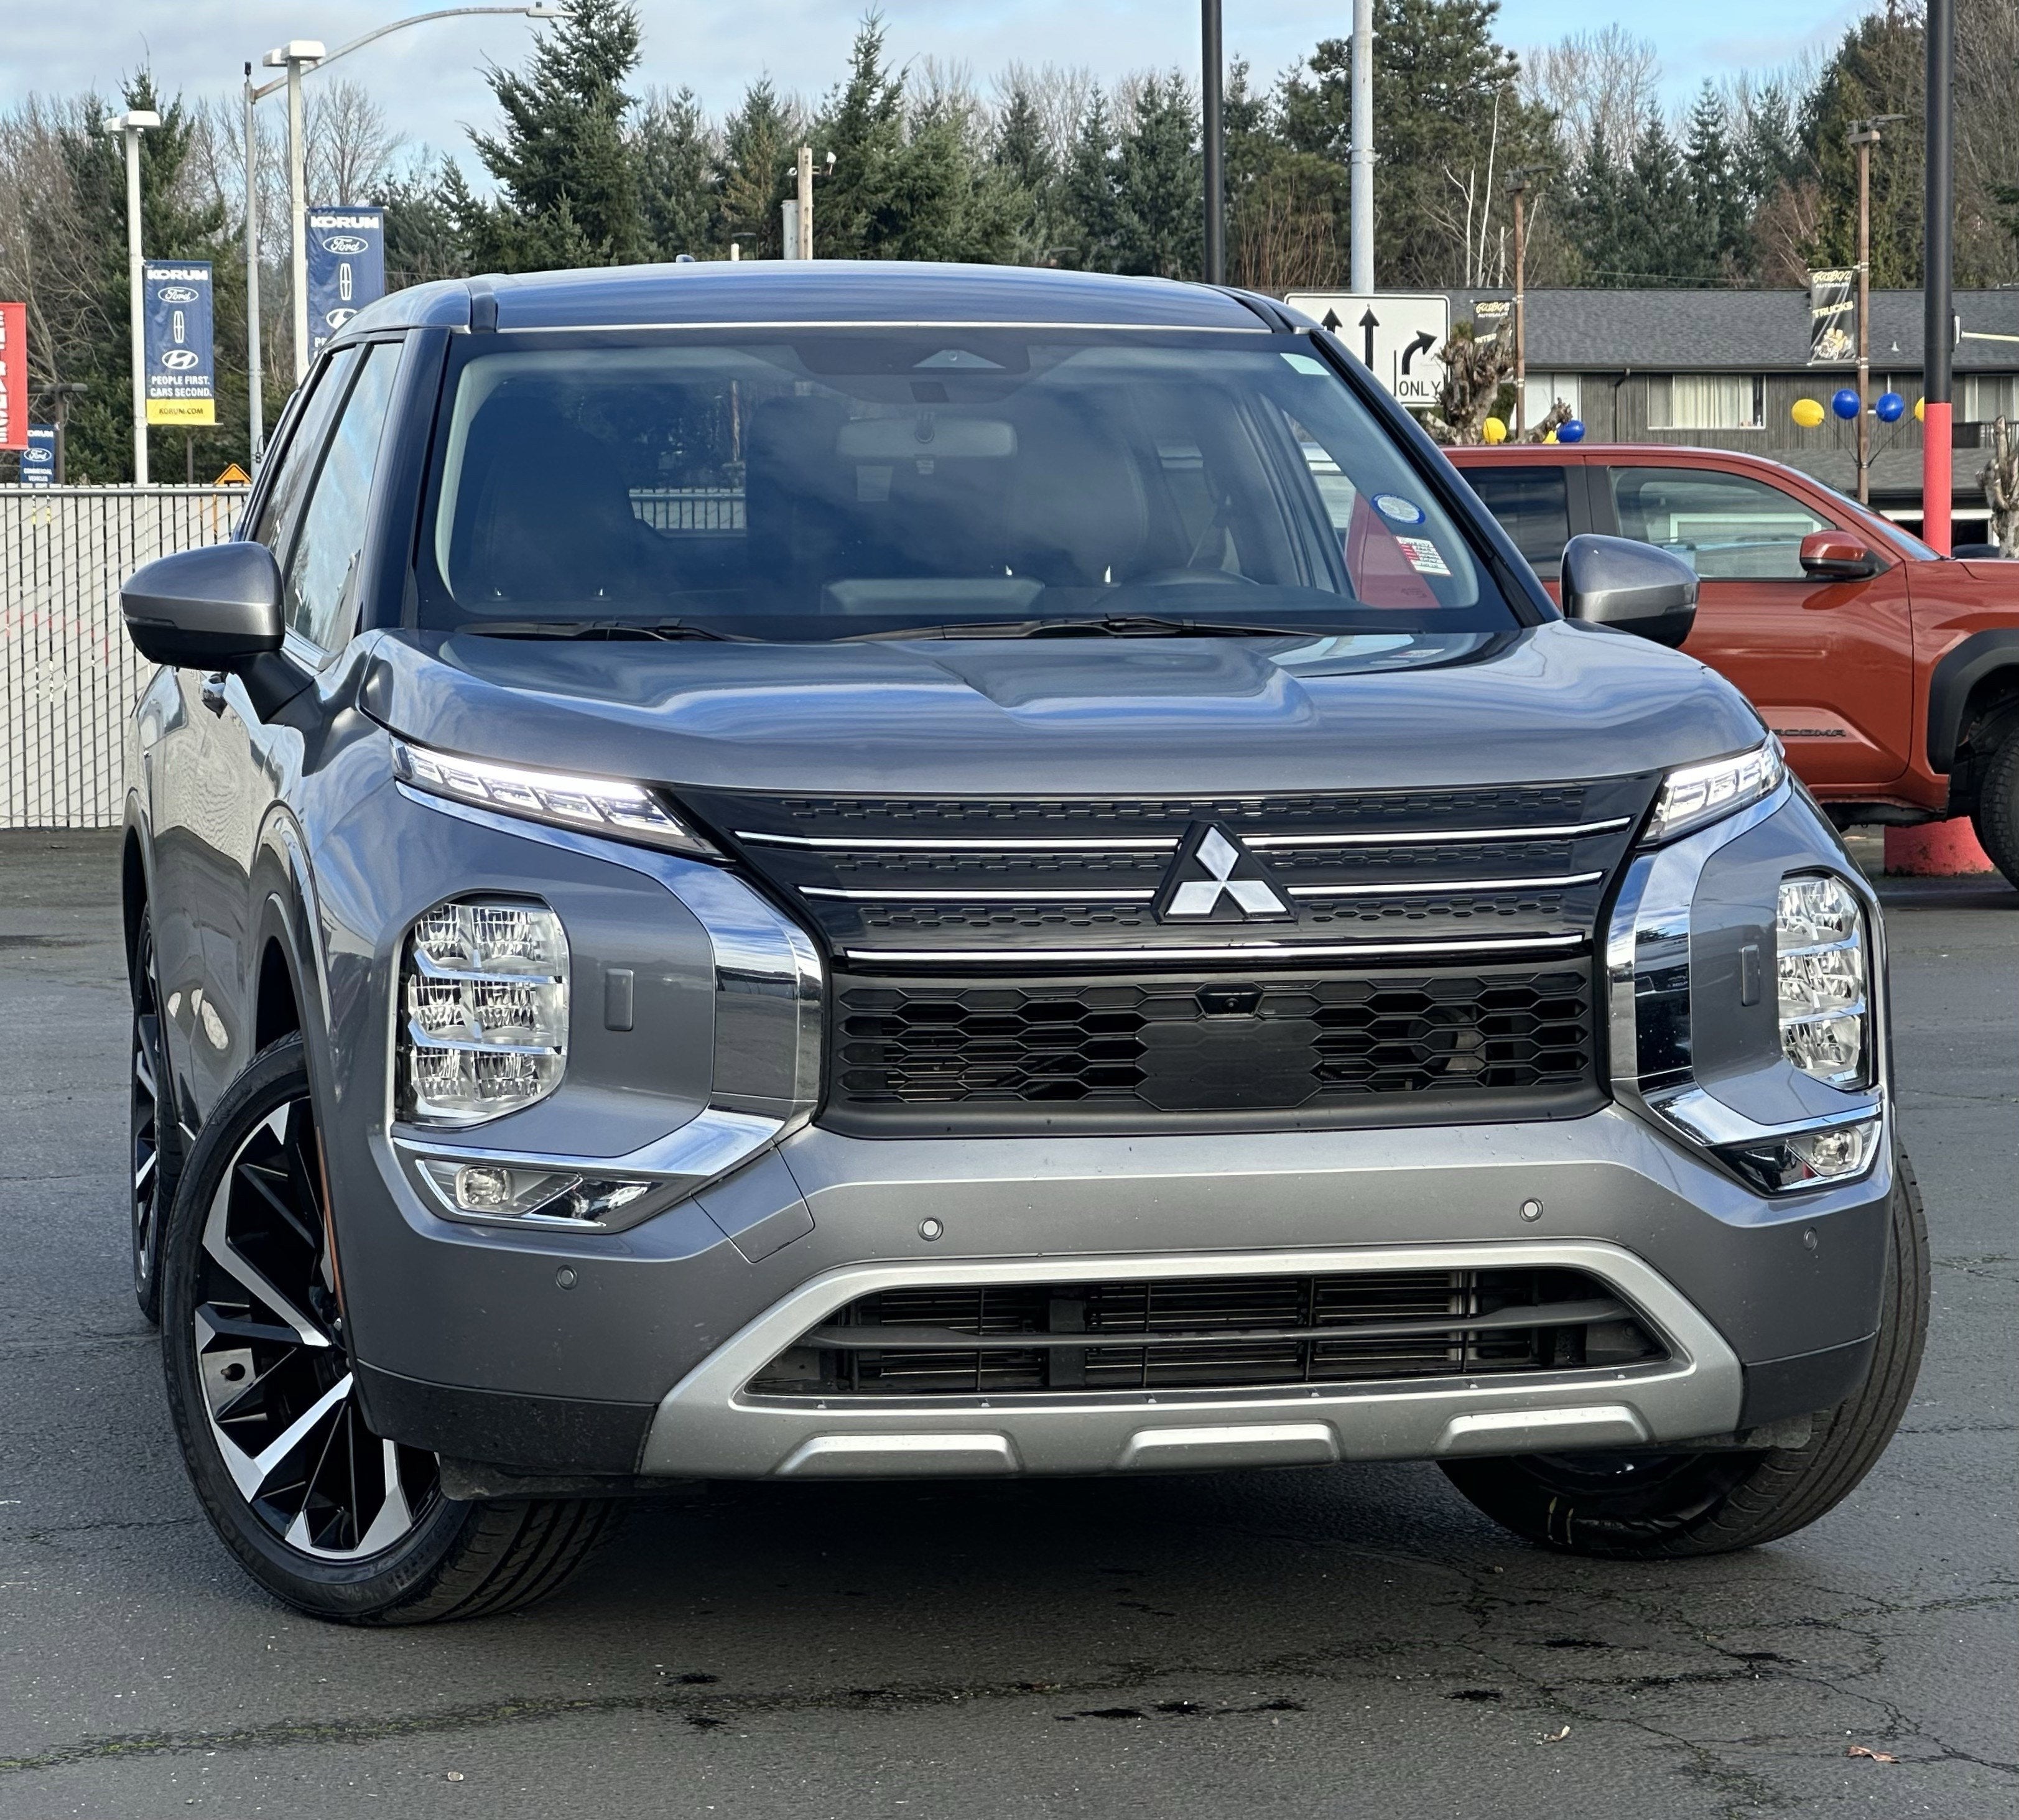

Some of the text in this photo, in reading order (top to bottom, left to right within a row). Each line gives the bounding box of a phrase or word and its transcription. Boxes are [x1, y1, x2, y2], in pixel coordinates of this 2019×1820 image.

[310, 216, 379, 228] KORUM
[147, 269, 208, 280] KORUM
[1812, 300, 1854, 318] TRUCKS
[151, 376, 210, 384] PEOPLE FIRST.
[150, 388, 212, 397] CARS SECOND.
[1399, 381, 1441, 396] ONLY
[1771, 728, 1846, 736] ACOMA
